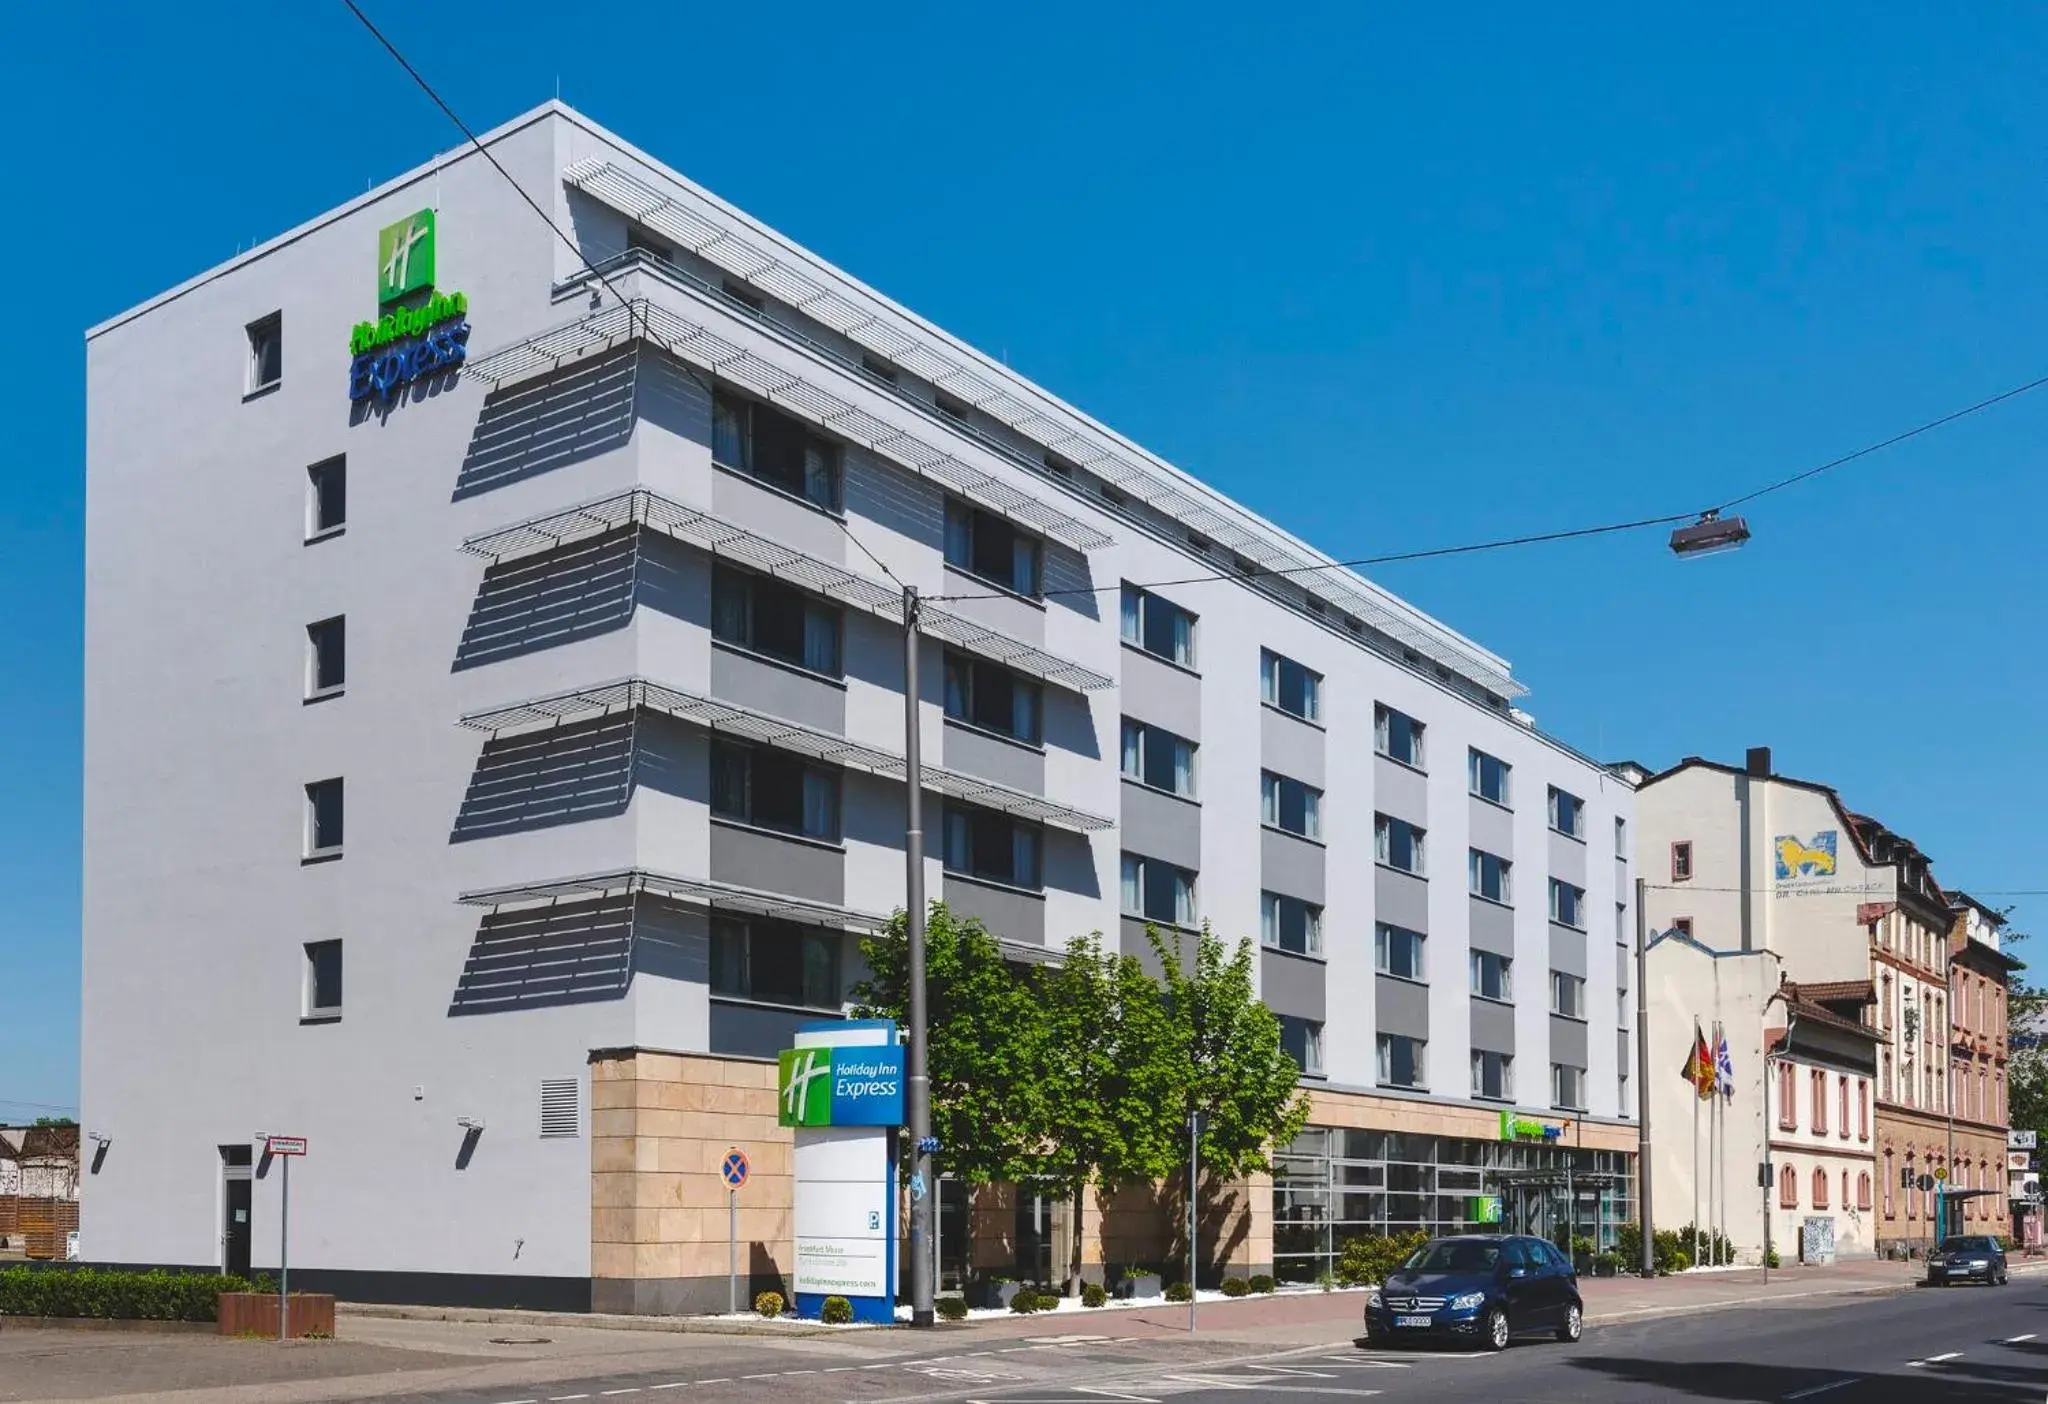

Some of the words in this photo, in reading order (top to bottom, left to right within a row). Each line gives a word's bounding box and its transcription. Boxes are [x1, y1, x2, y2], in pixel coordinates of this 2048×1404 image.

[350, 306, 430, 357] Holiday
[429, 289, 468, 324] Inn
[349, 322, 472, 400] Express
[836, 1062, 878, 1078] Holiday
[878, 1061, 898, 1075] Inn
[836, 1078, 897, 1100] Express
